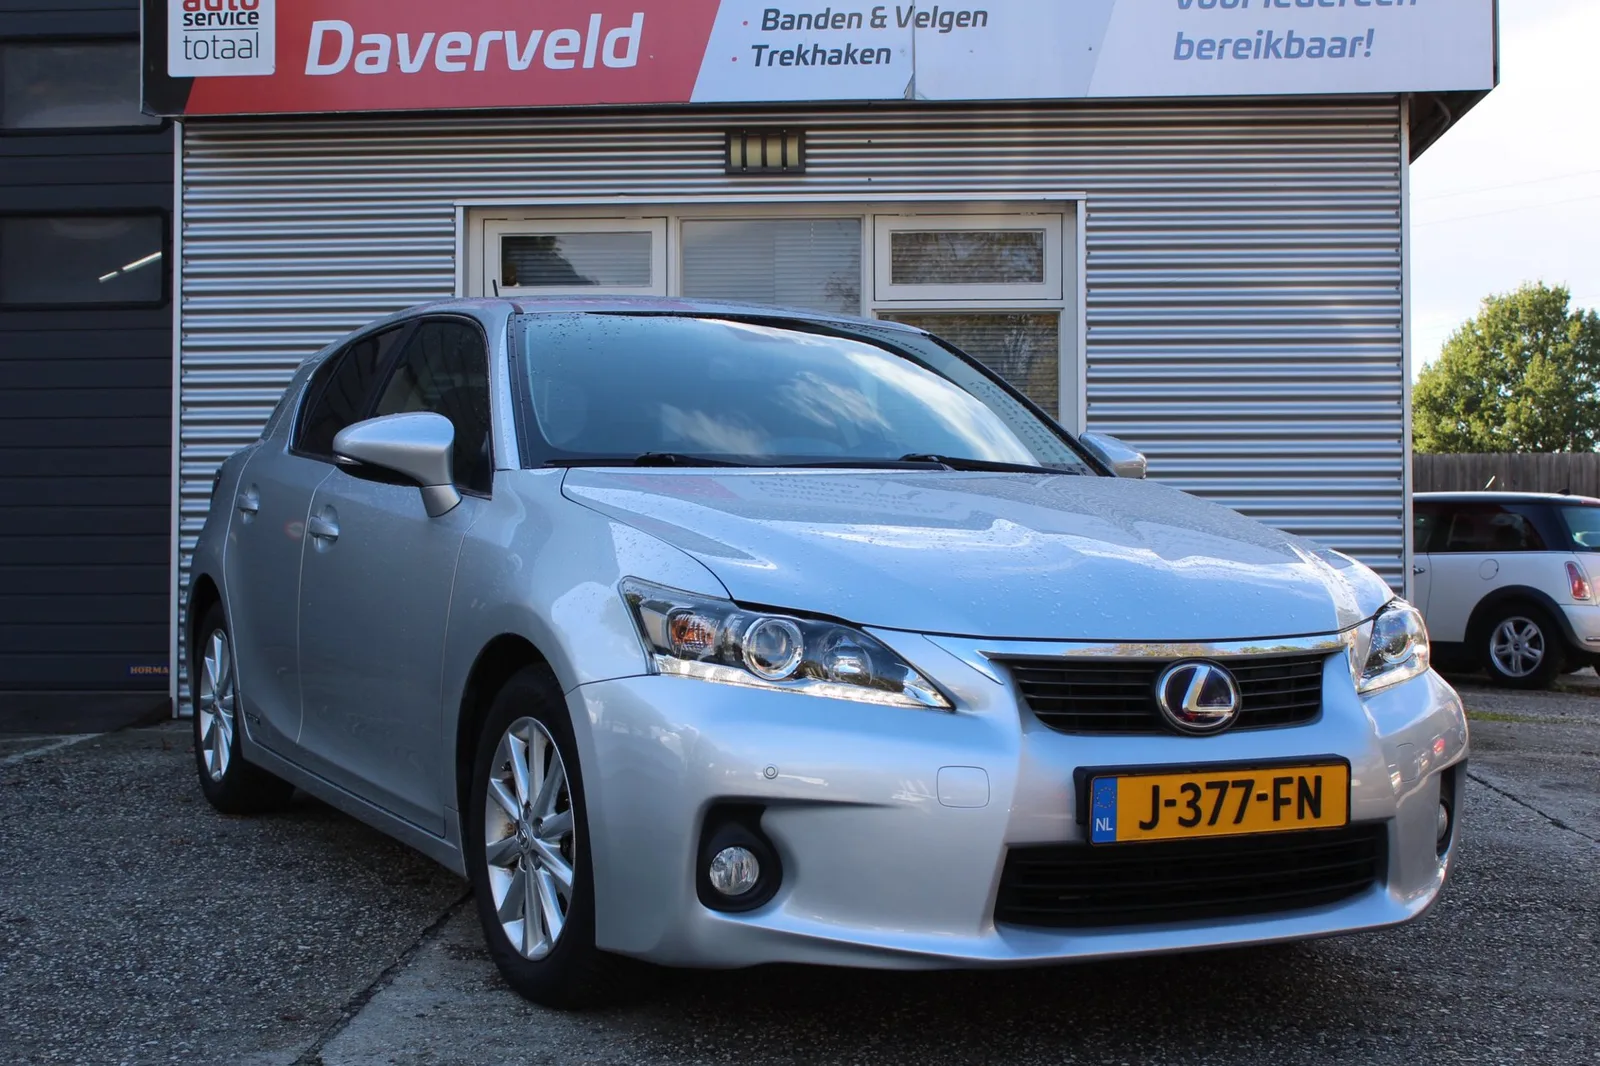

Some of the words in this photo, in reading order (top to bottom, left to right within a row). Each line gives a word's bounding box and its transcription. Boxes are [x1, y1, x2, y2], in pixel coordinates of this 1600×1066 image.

[183, 11, 259, 27] service
[761, 8, 863, 31] Banden
[870, 6, 888, 29] &
[895, 6, 989, 33] Velgen
[183, 31, 259, 60] totaal
[305, 12, 645, 76] Daverveld
[751, 43, 892, 67] Trekhaken
[1173, 28, 1375, 60] bereikbaar!
[1138, 774, 1322, 831] J-377-FN
[1095, 817, 1114, 832] NL
